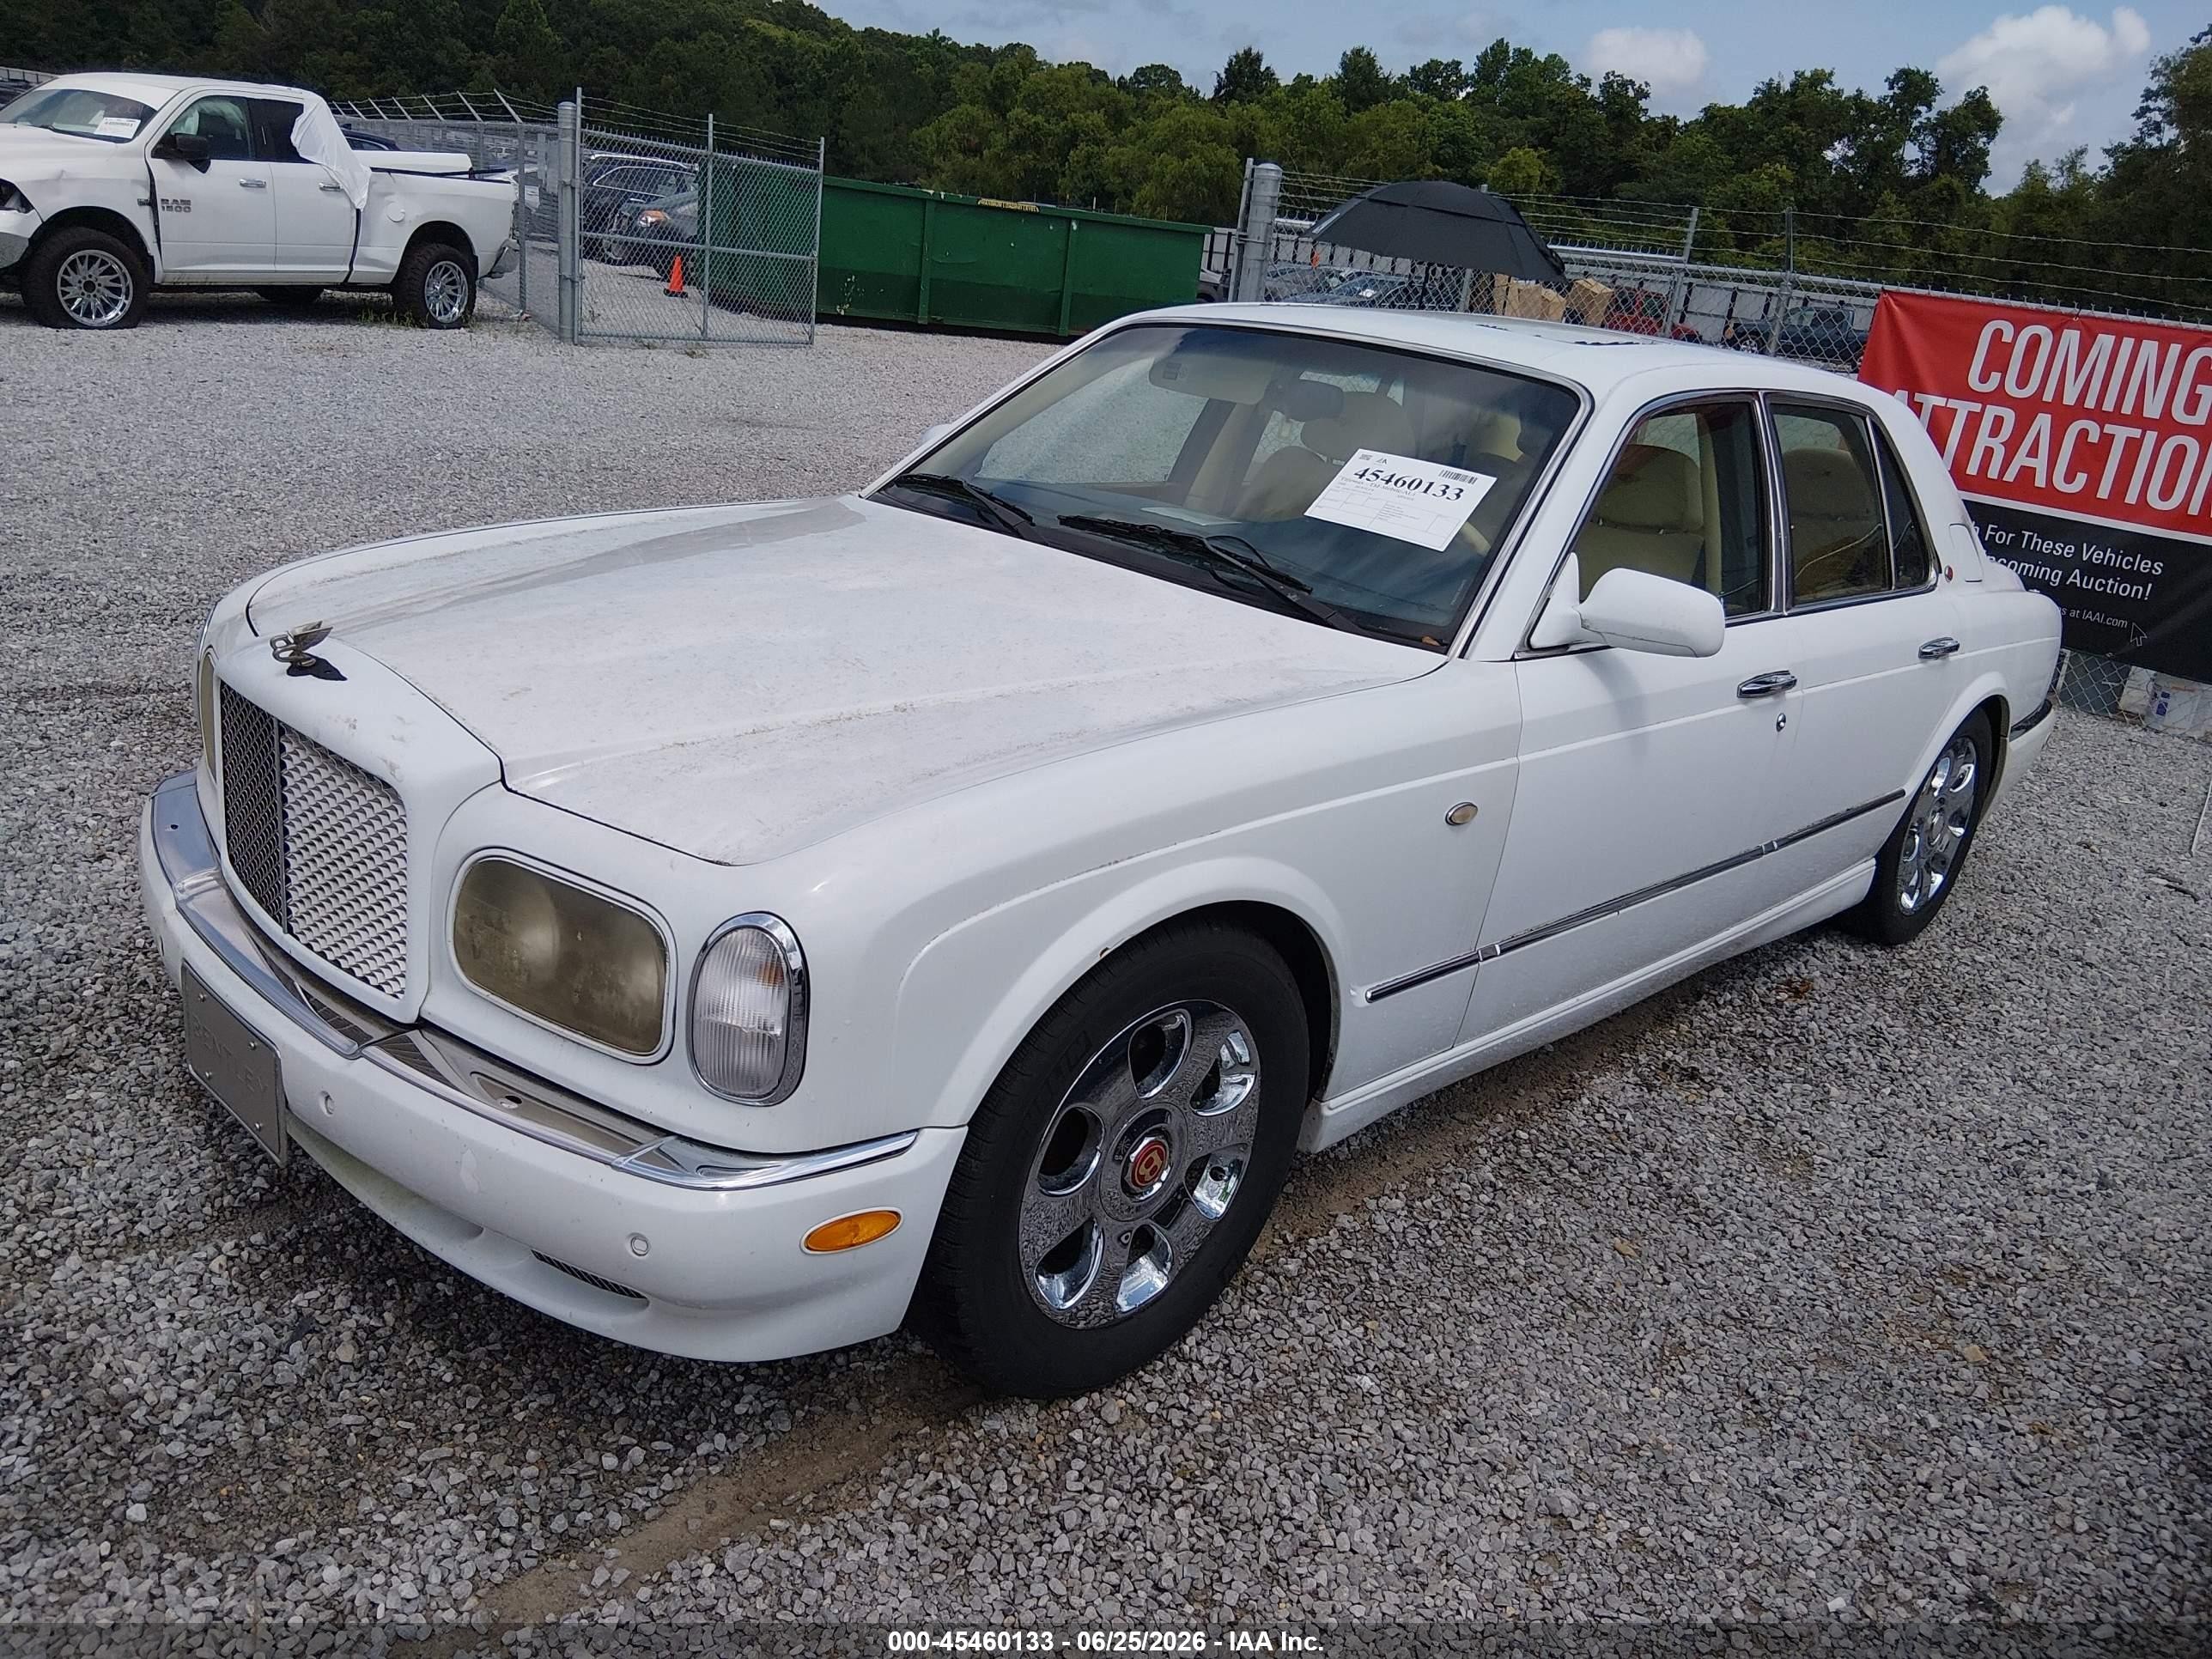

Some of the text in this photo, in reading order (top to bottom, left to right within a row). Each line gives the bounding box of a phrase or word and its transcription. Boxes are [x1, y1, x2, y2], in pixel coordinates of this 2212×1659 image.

[1967, 319, 2212, 426] COMING
[1893, 390, 2212, 518] TTRACTIO
[1353, 467, 1464, 501] 45460133
[1984, 524, 2015, 545] For
[2021, 531, 2075, 558] These
[2082, 543, 2164, 575] Vehicles
[2066, 568, 2153, 600] Auction!
[2069, 609, 2081, 618] at
[2081, 610, 2128, 629] IAAI.com
